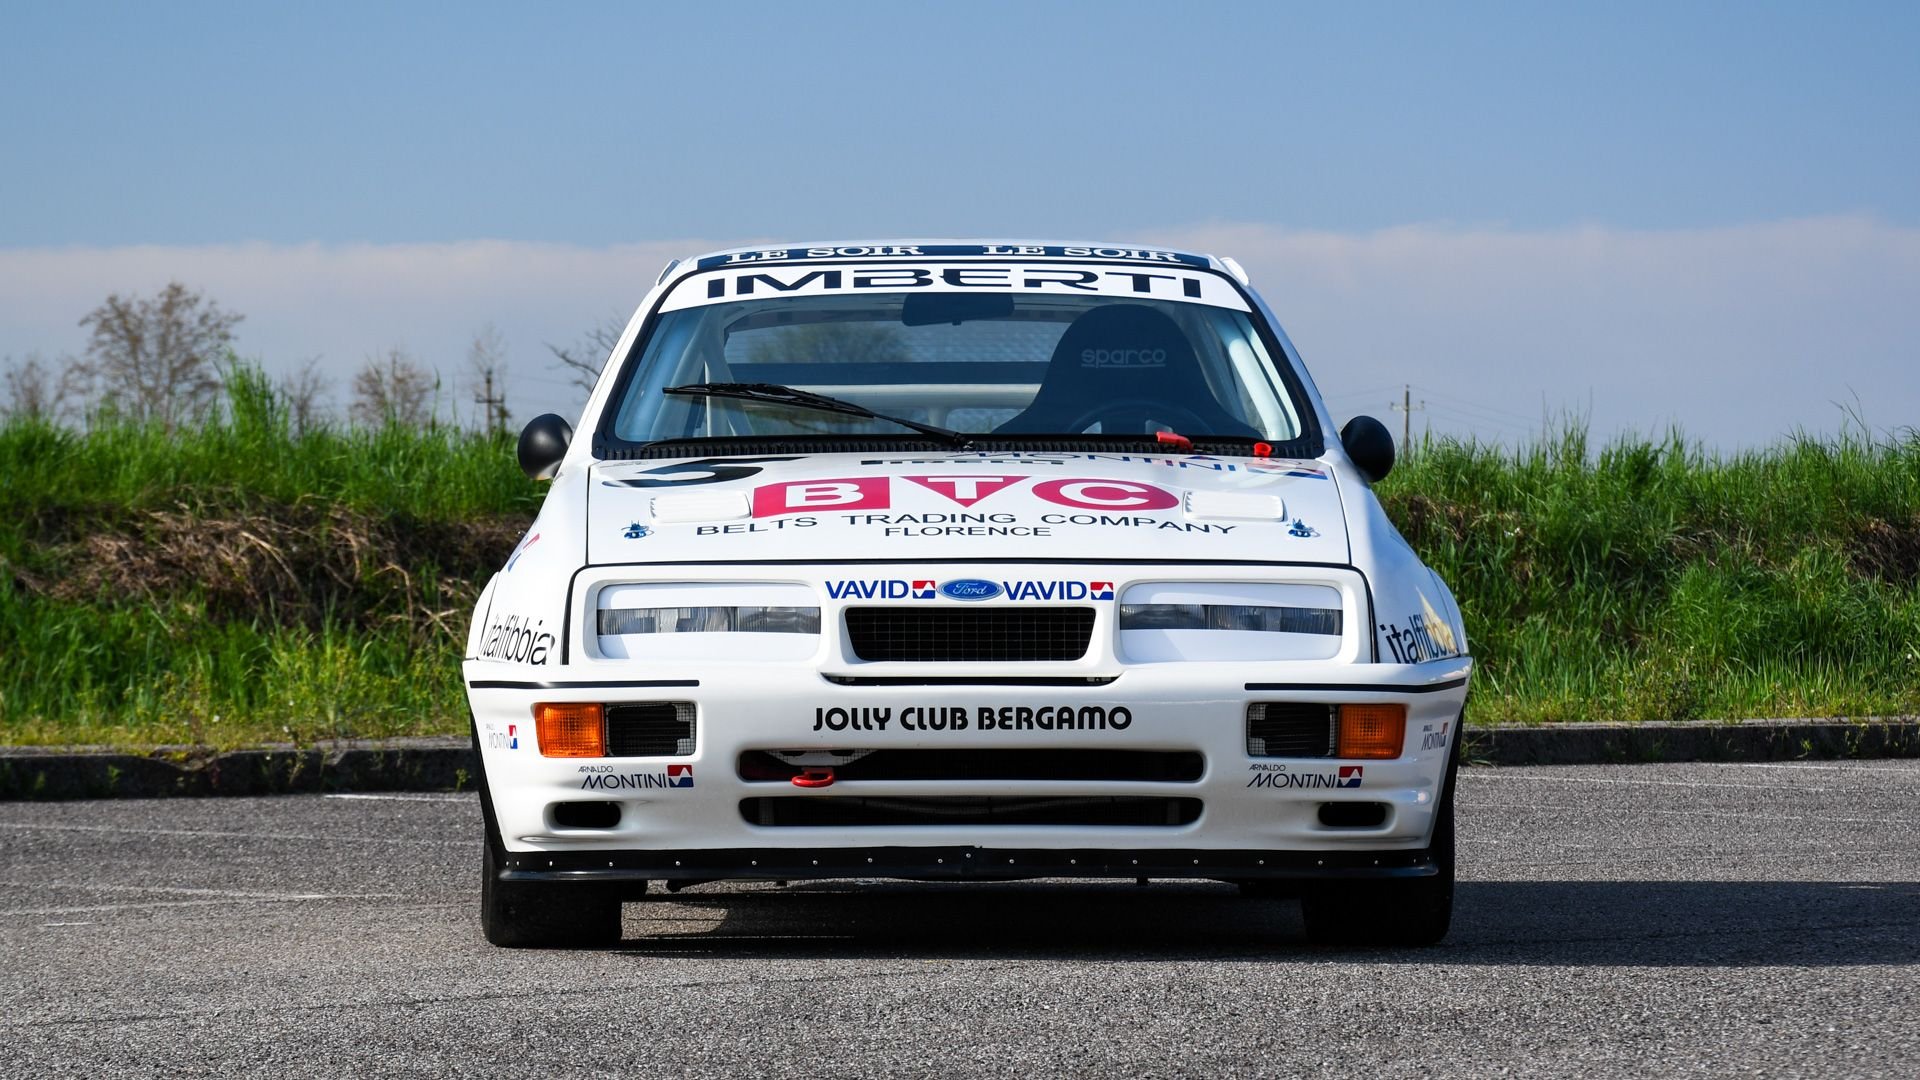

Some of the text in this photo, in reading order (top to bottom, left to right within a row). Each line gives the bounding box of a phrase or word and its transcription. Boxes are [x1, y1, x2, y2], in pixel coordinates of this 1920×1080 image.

[725, 246, 925, 264] LE SOIR
[983, 245, 1182, 263] LE SOIR
[706, 268, 1203, 300] IMBERTI
[1080, 348, 1167, 369] sparco
[696, 513, 1238, 536] BELTS TRADING COMPANY
[884, 526, 1053, 538] FLORENCE
[824, 580, 909, 600] VAVID
[952, 582, 988, 595] Ford
[1002, 581, 1088, 601] VAVID
[813, 706, 1133, 732] JOLLY CLUB BERGAMO
[577, 765, 614, 774] ARNALDO
[1249, 763, 1287, 772] ARNALDO
[580, 773, 667, 790] MONTINI
[1246, 772, 1338, 789] MONTINI
